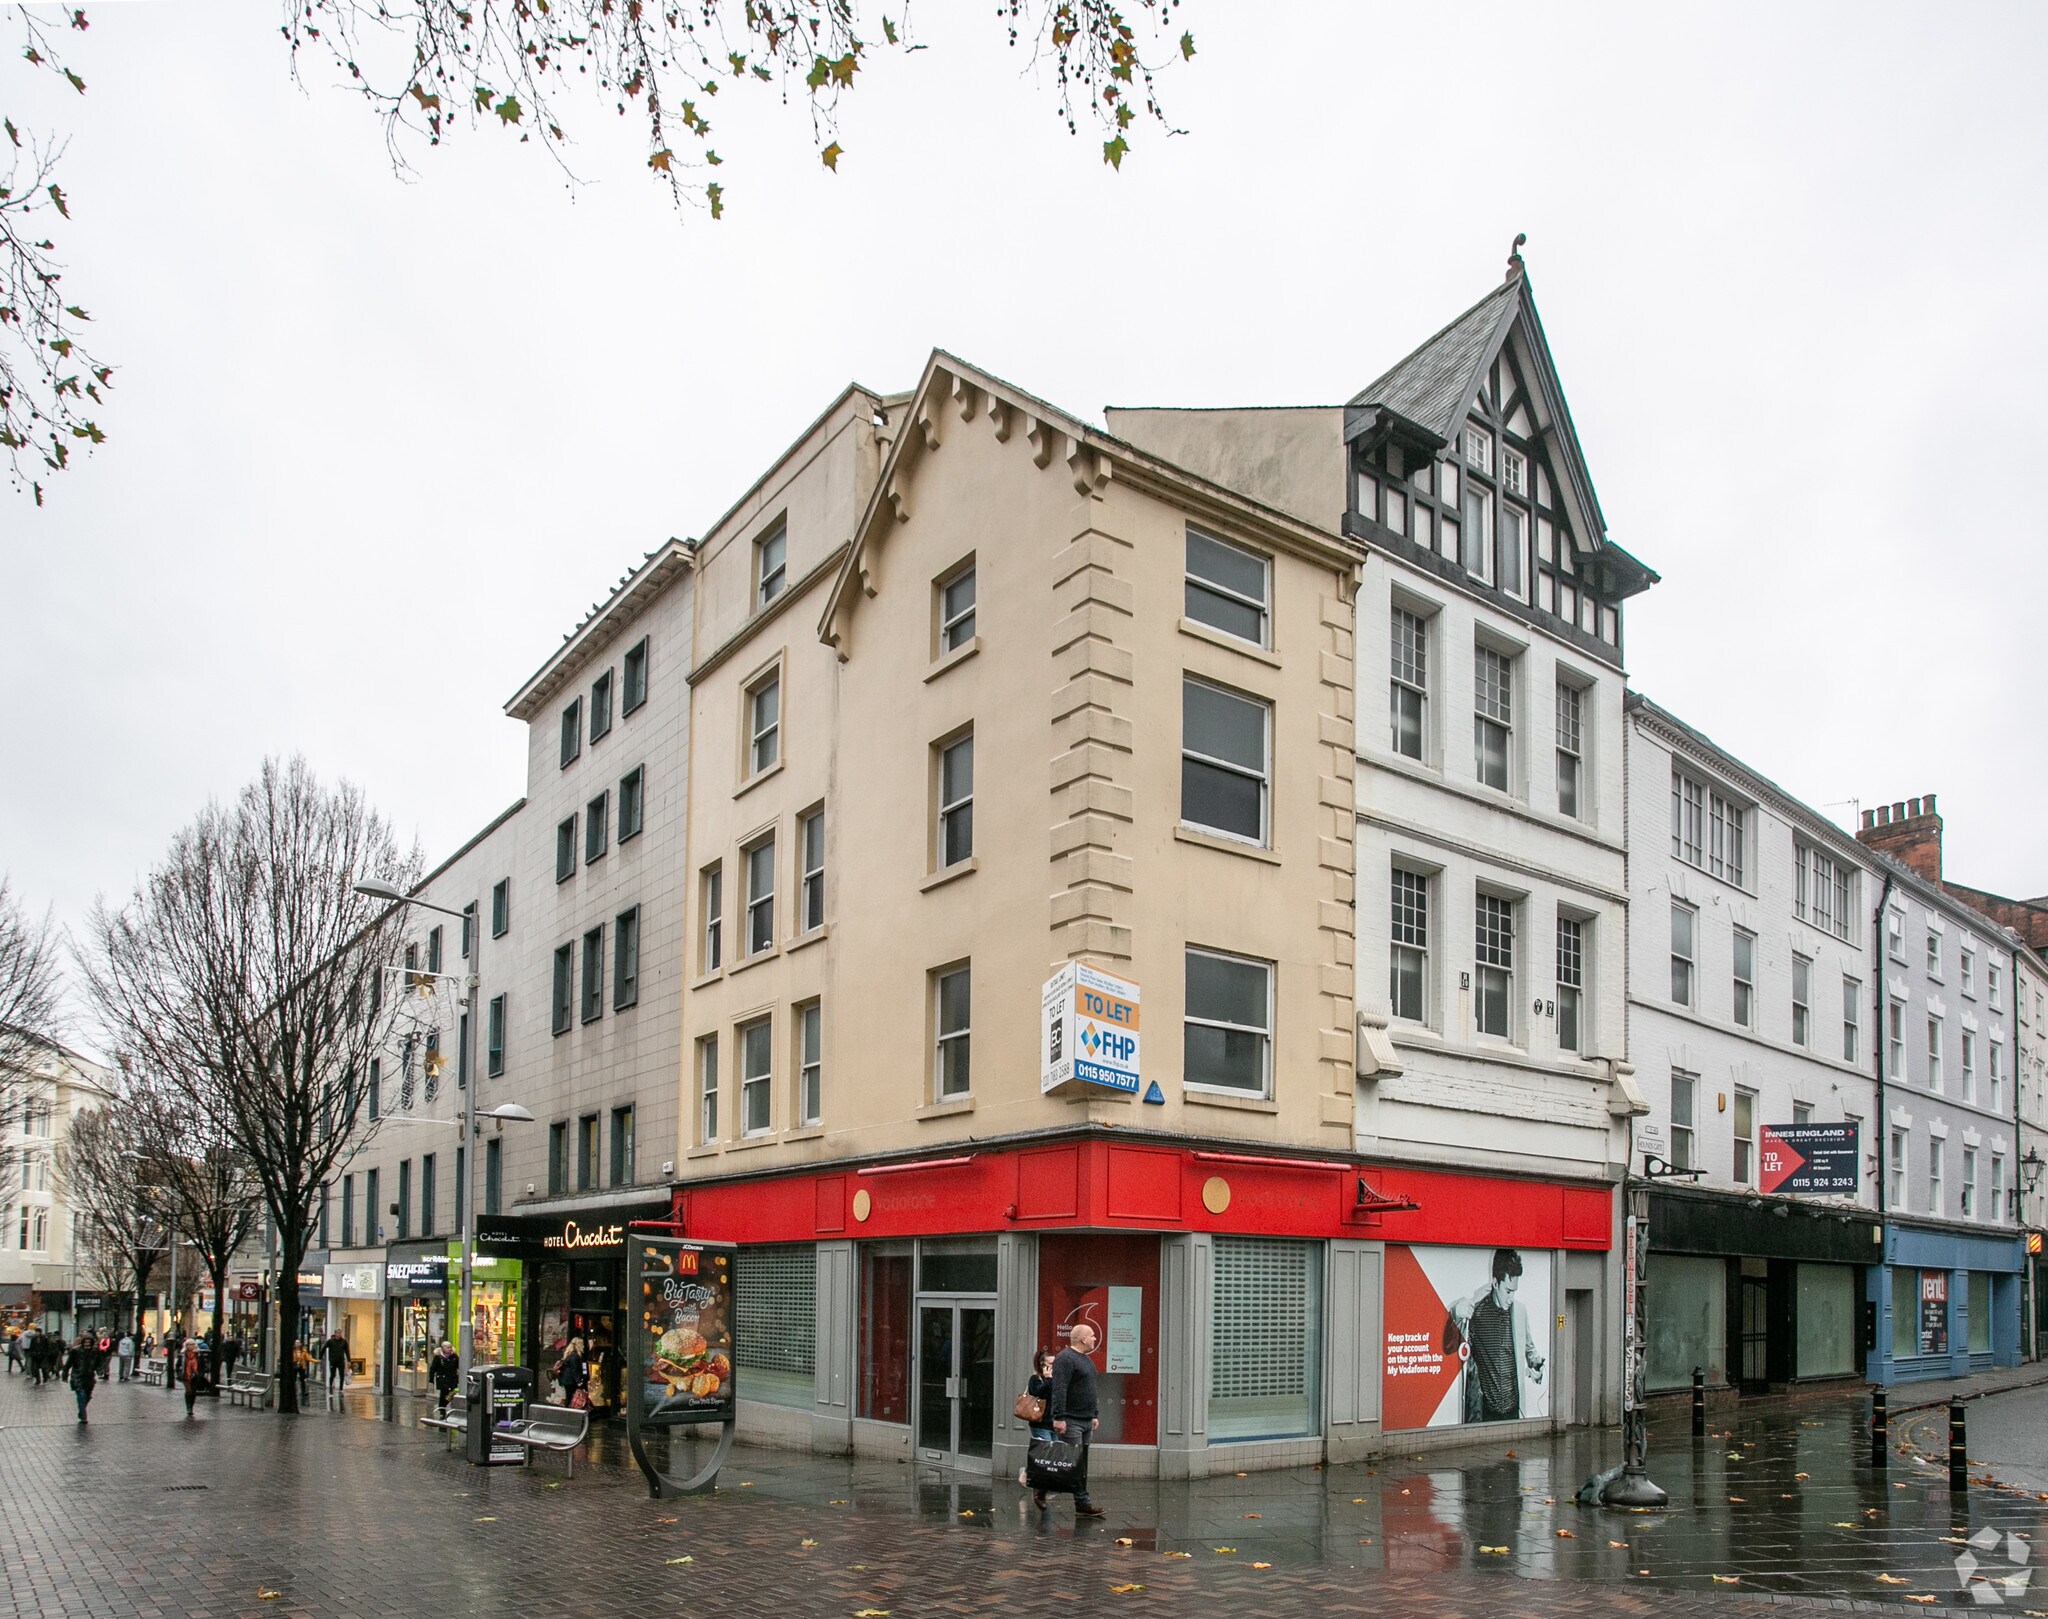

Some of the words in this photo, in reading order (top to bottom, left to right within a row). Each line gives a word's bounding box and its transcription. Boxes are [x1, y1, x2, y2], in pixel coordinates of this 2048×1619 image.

[1049, 1006, 1057, 1019] TO
[1057, 999, 1066, 1014] LET
[1084, 992, 1104, 1015] TO
[1106, 1000, 1132, 1023] LET
[1102, 1031, 1136, 1062] FHP
[1078, 1063, 1098, 1080] 0115
[1099, 1069, 1115, 1083] 950
[1116, 1073, 1136, 1088] 7577
[1765, 1130, 1795, 1138] INNES
[1796, 1129, 1845, 1137] ENGLAND
[1765, 1152, 1778, 1161] TO
[1764, 1162, 1783, 1172] LET
[1793, 1178, 1810, 1187] 0115
[1813, 1178, 1829, 1187] 924
[1832, 1177, 1853, 1186] 3243
[544, 1236, 565, 1248] HOTEL
[1923, 1272, 1945, 1300] rent!
[663, 1278, 684, 1308] Big
[680, 1281, 711, 1309] Tasty
[683, 1303, 697, 1313] with
[674, 1308, 700, 1324] Bacon
[1387, 1333, 1404, 1344] Keep
[1405, 1333, 1422, 1341] track
[1422, 1332, 1430, 1341] of
[1387, 1345, 1403, 1355] your
[1404, 1344, 1429, 1352] account
[1397, 1355, 1407, 1363] the
[1408, 1356, 1417, 1365] go
[1418, 1354, 1432, 1363] with
[1432, 1354, 1443, 1362] the
[1387, 1366, 1398, 1376] My
[1398, 1365, 1428, 1374] Vodafone
[1428, 1365, 1441, 1374] app
[1034, 1458, 1051, 1466] NEW
